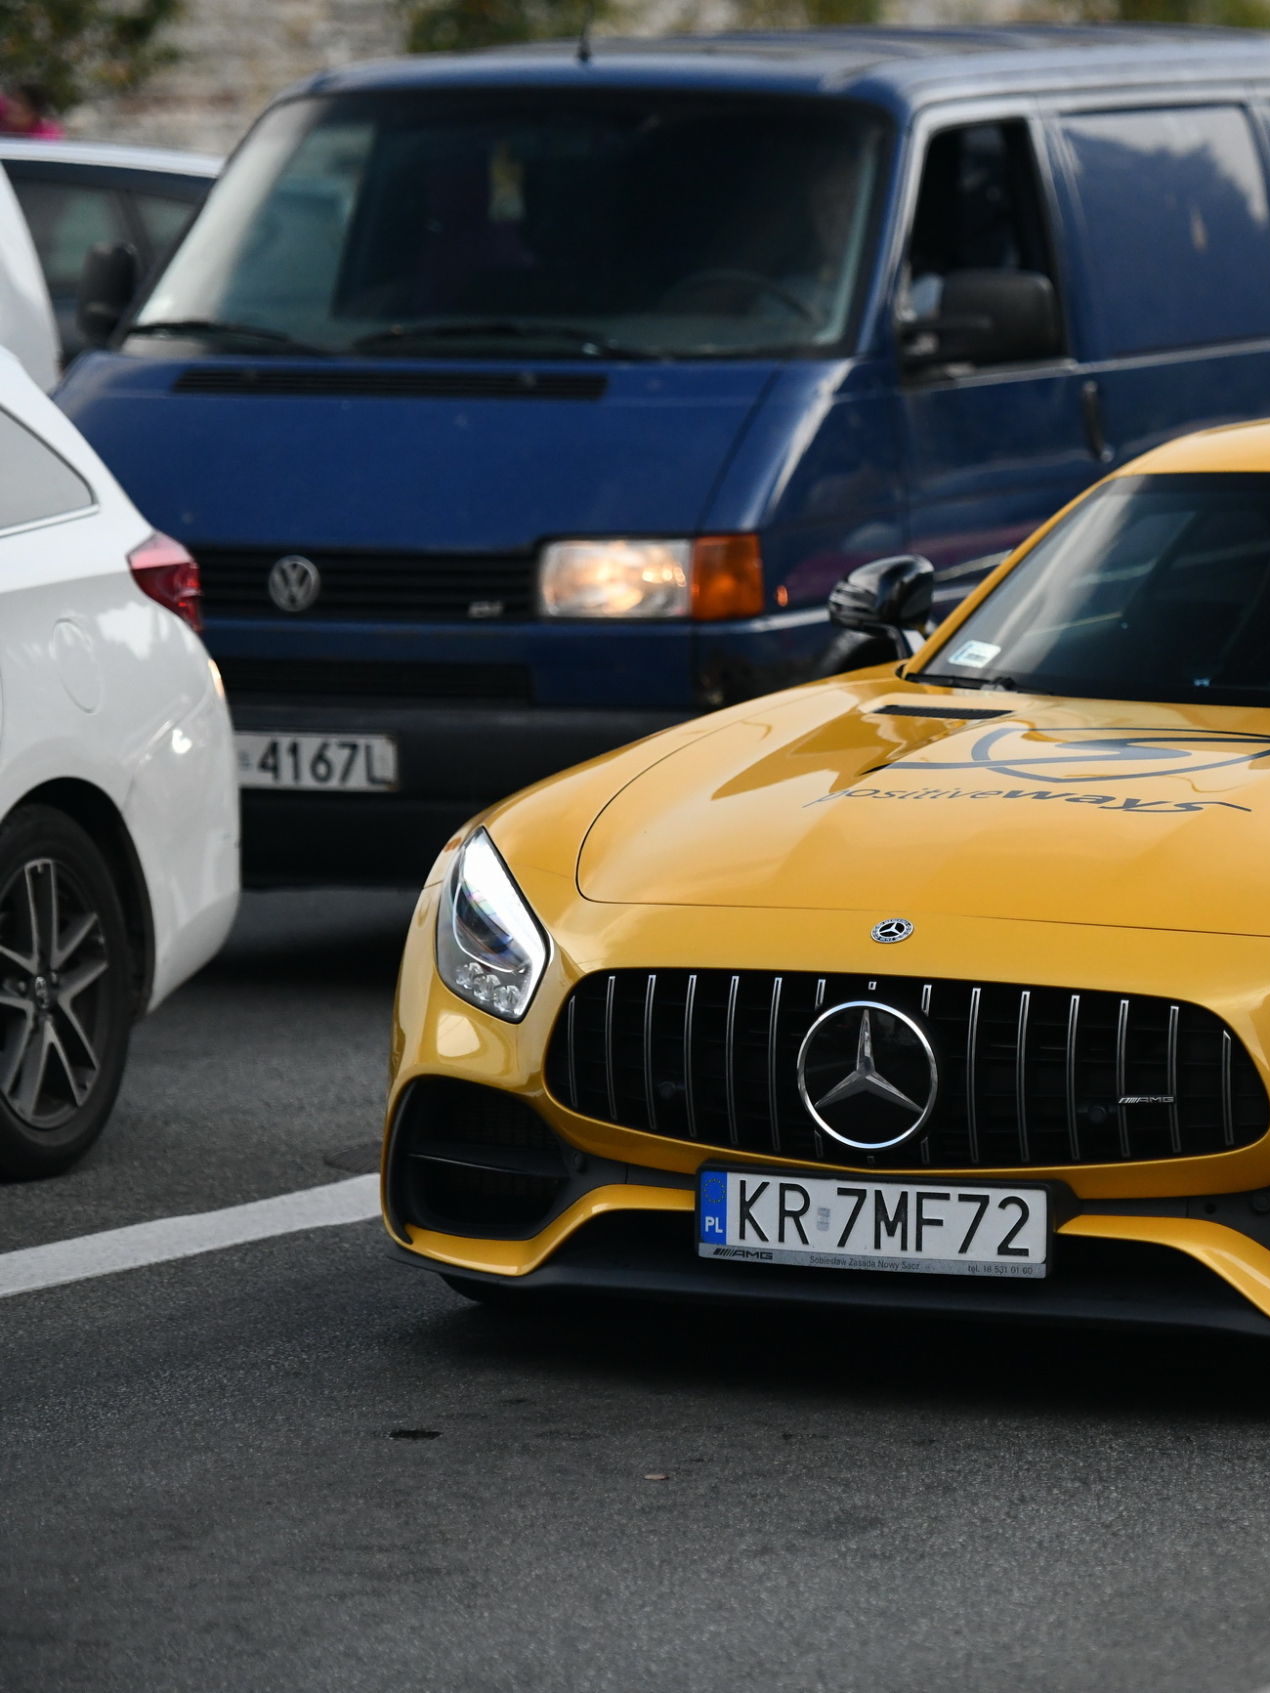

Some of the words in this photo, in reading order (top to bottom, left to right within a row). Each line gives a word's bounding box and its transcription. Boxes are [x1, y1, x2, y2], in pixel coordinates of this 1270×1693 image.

[258, 738, 394, 783] 4167L
[705, 1216, 723, 1233] PL
[739, 1180, 810, 1245] KR
[836, 1187, 1030, 1257] 7MF72
[849, 1258, 876, 1268] Zasada
[878, 1261, 899, 1270] Nowy
